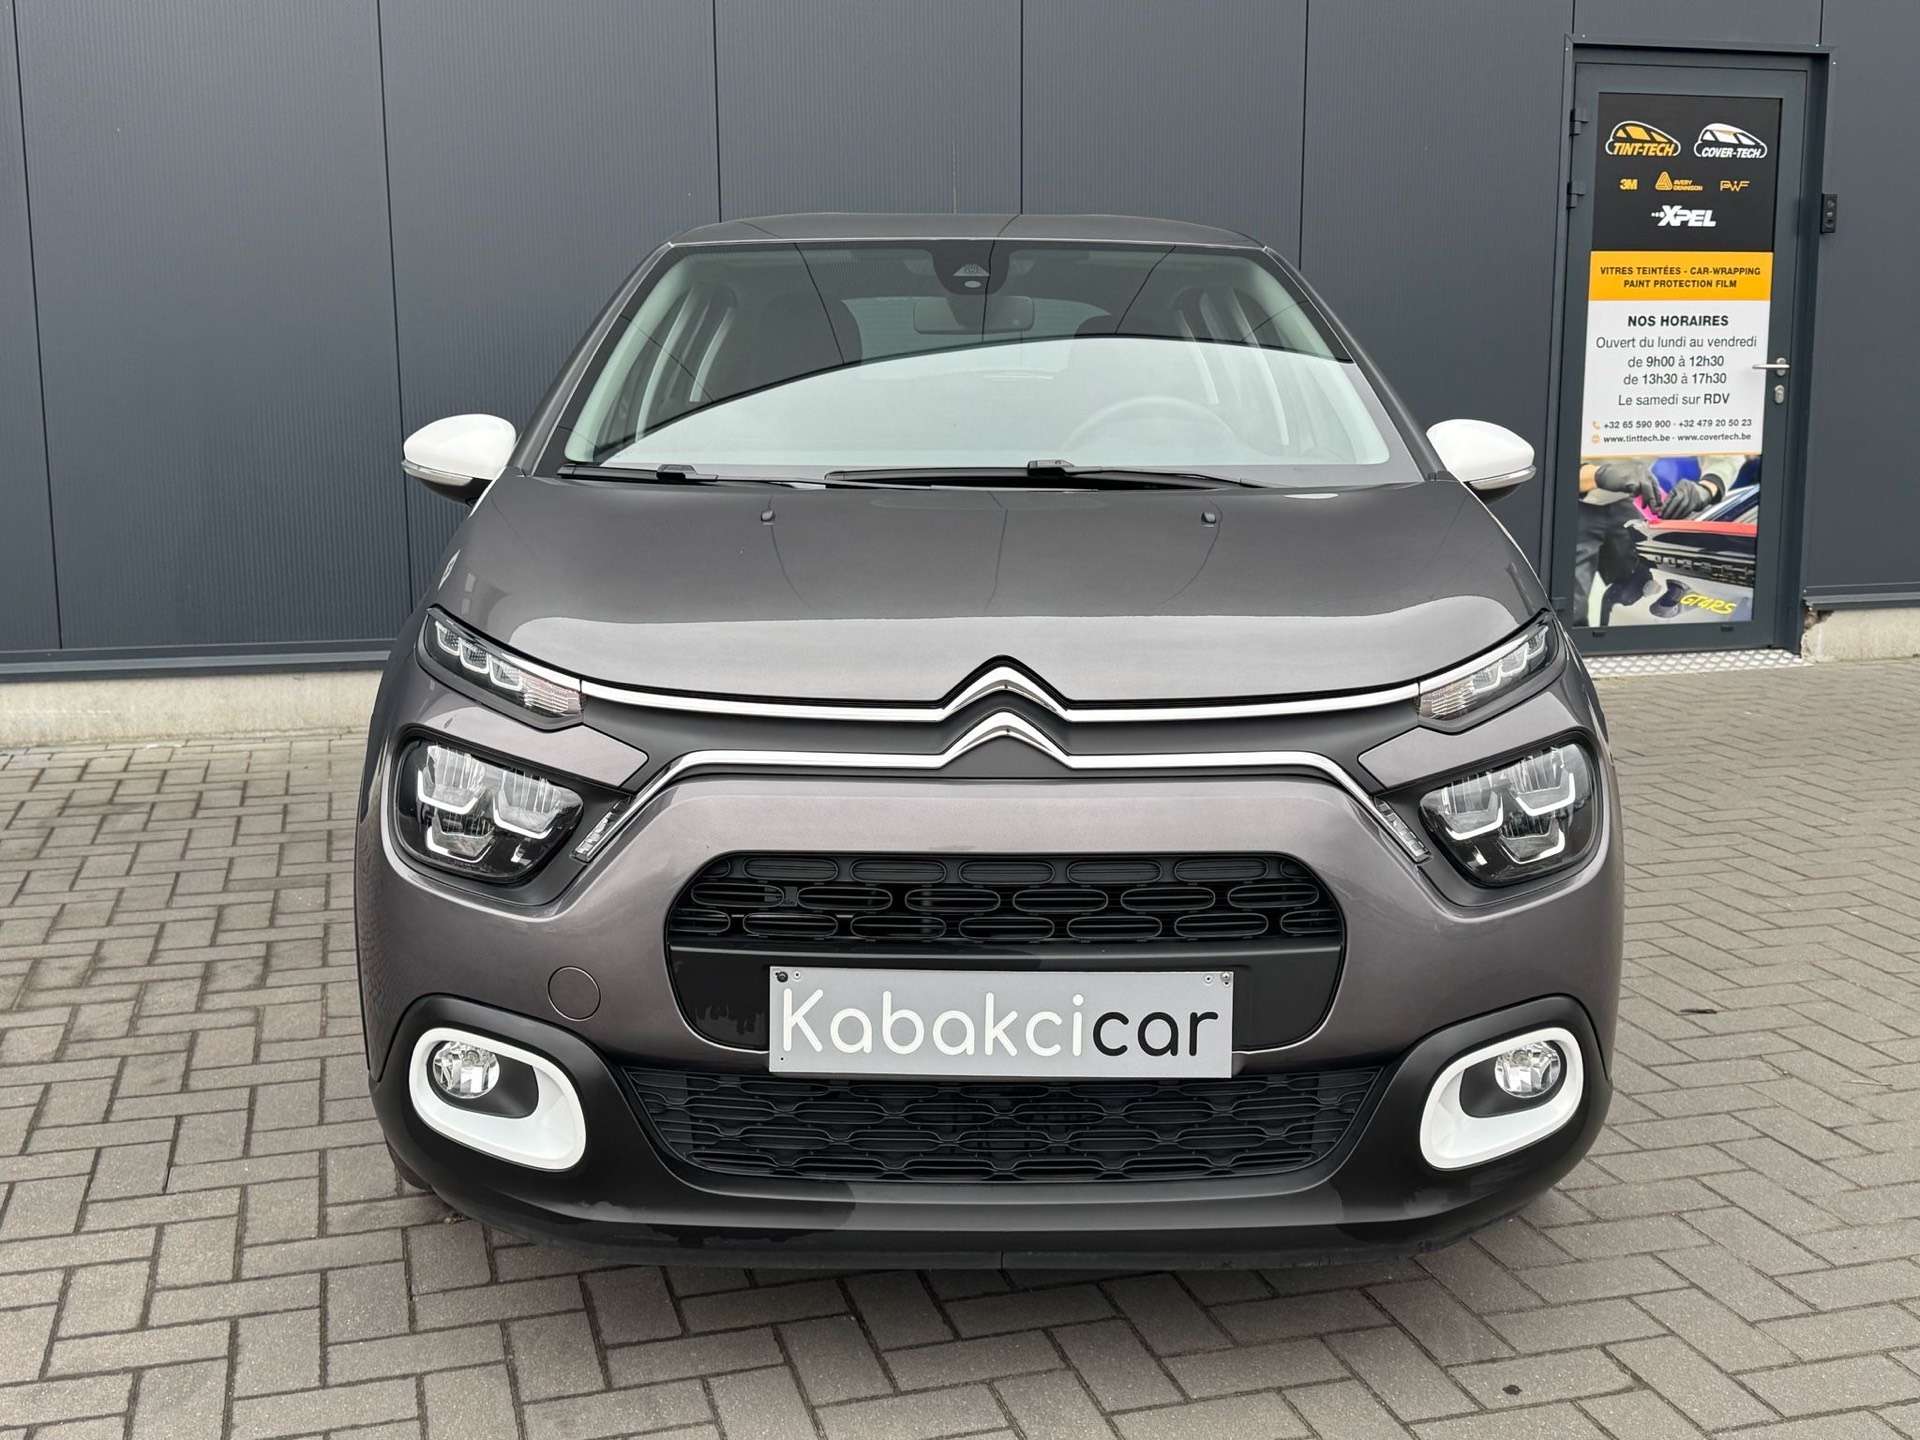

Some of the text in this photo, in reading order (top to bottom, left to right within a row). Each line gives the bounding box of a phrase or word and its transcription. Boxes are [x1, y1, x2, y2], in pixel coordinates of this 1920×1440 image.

[1613, 142, 1676, 157] TINT-TECH
[1701, 146, 1762, 159] COVER-TECH
[1619, 178, 1638, 190] 3M
[1658, 205, 1717, 227] XPEL
[1600, 266, 1633, 275] VITRES
[1637, 265, 1681, 275] TEINTÉES
[1690, 267, 1761, 276] CAR-WRAPPING
[1624, 280, 1737, 288] PAINT PROTECTION FILM
[1627, 315, 1729, 327] NOS HORAIRES
[1596, 336, 1757, 349] Ouvert du lundi au vendredi
[1627, 355, 1725, 368] de 9h00 à 12h30
[1623, 372, 1727, 385] de 13h30 à 17h30
[1618, 393, 1730, 406] Le samedi sur RDV
[1603, 421, 1620, 429] +32
[1622, 421, 1633, 429] 65
[1636, 421, 1652, 429] 590
[1654, 420, 1671, 428] 900
[1679, 420, 1695, 428] +32
[1728, 419, 1739, 427] 50
[1741, 419, 1752, 427] 23
[1603, 435, 1671, 443] www.tinttech.be
[1677, 433, 1751, 441] www.covertech.be
[782, 988, 1219, 1057] Kabakcicar
